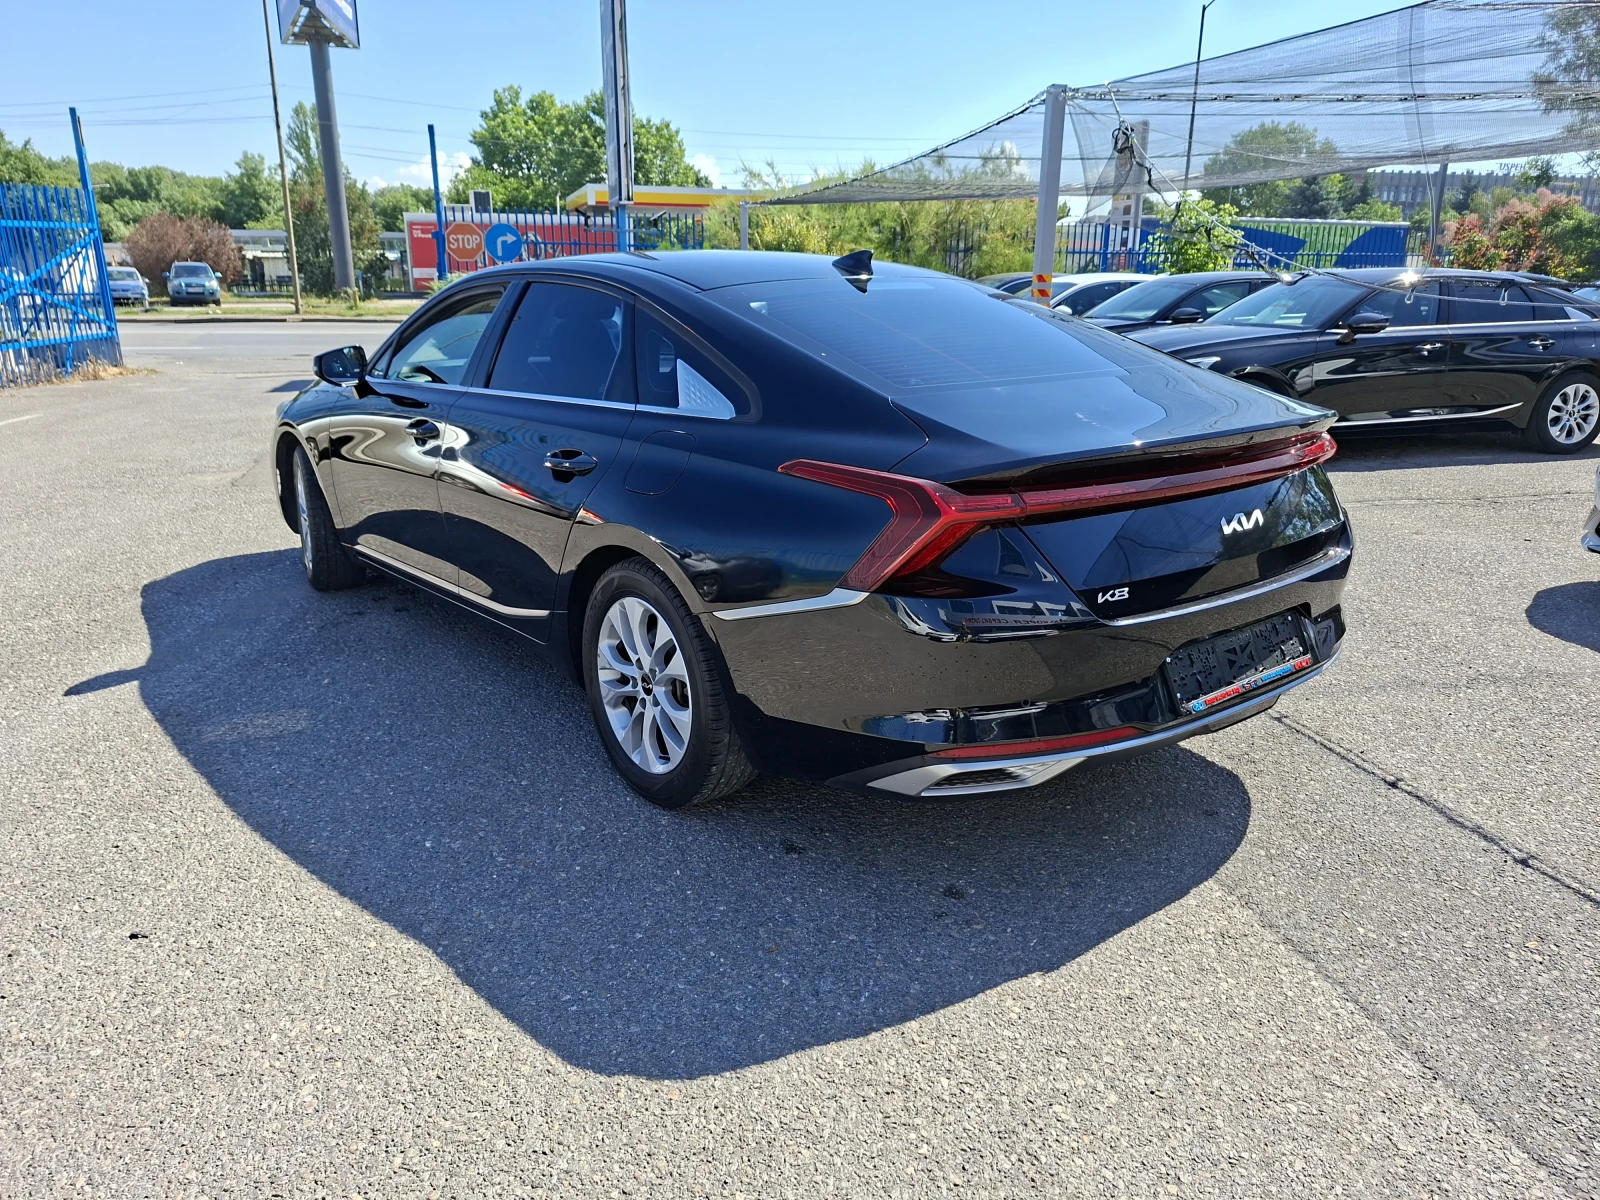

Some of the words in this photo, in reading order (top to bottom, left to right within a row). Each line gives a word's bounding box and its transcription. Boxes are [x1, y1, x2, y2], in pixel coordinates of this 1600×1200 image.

[449, 234, 480, 249] STOP
[1220, 508, 1264, 535] KIA
[1097, 587, 1129, 604] K8
